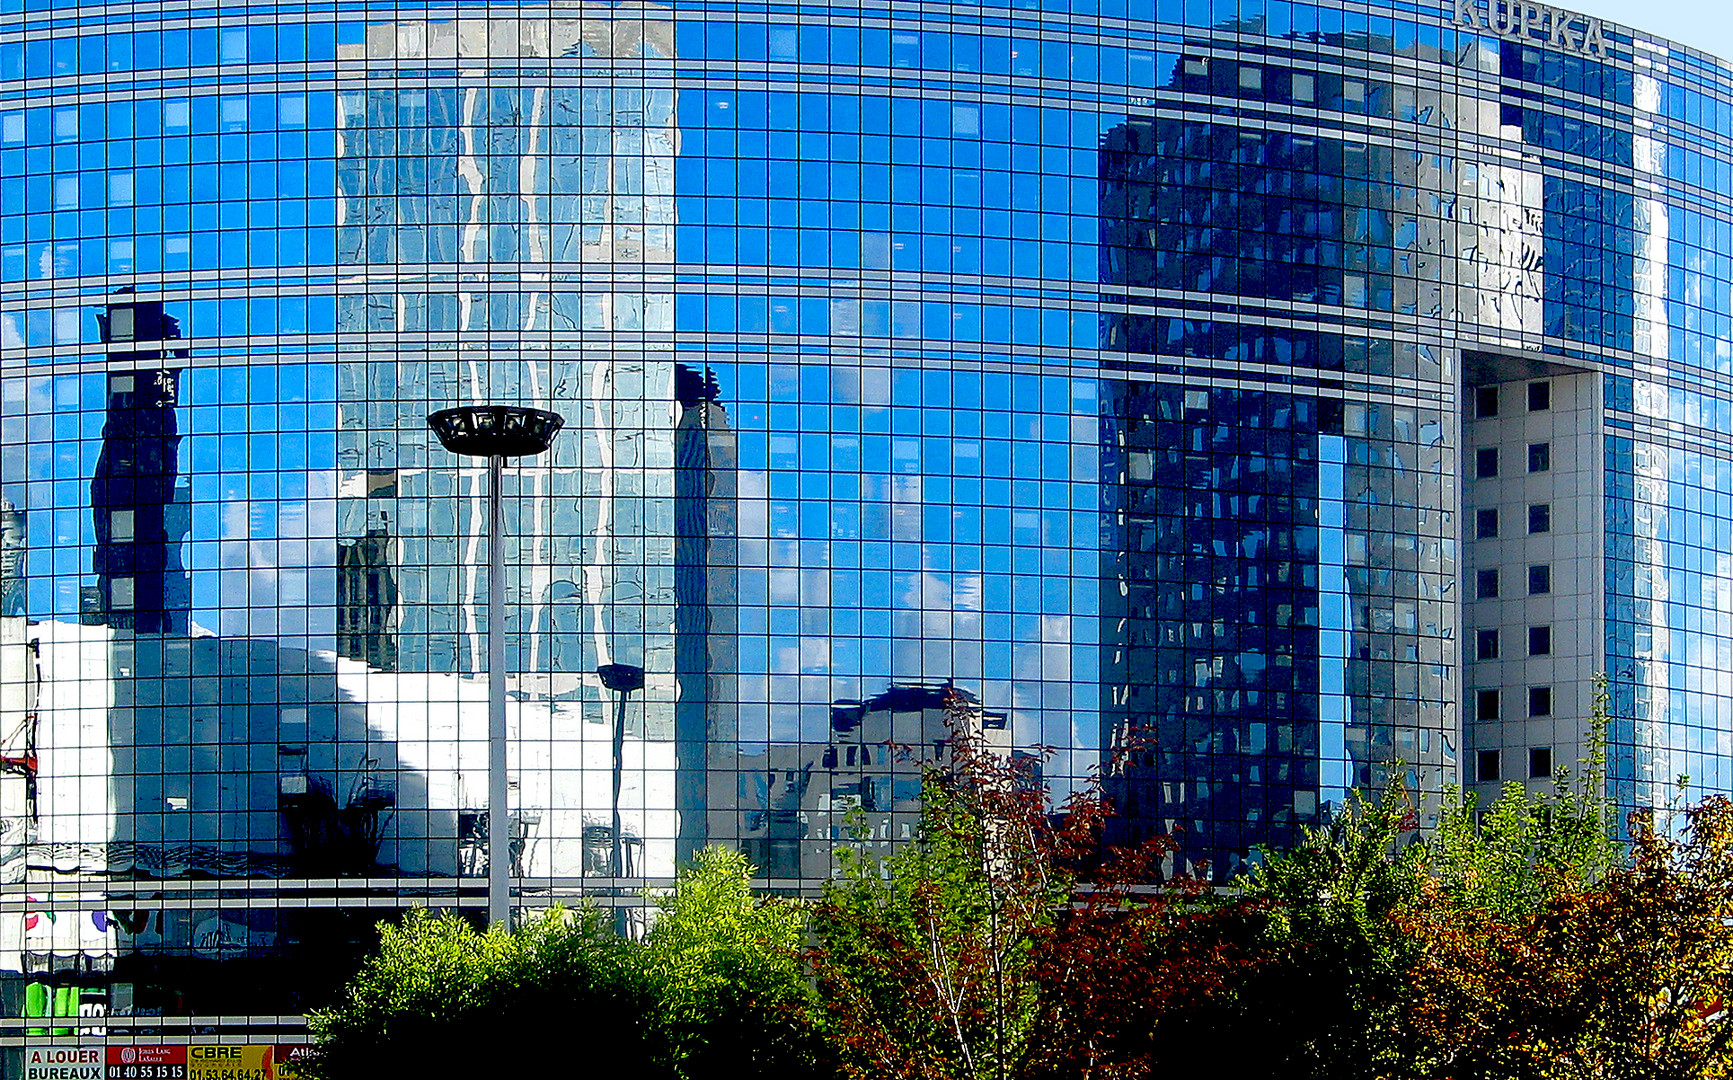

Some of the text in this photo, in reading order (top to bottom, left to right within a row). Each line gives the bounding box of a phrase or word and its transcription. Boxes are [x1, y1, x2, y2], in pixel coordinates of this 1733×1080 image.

[1451, 0, 1609, 59] KUPKA
[31, 1051, 99, 1063] A LOUER
[191, 1047, 242, 1058] CBRE
[29, 1068, 101, 1079] BUREAUX
[109, 1066, 183, 1078] 01 40 55 15 15
